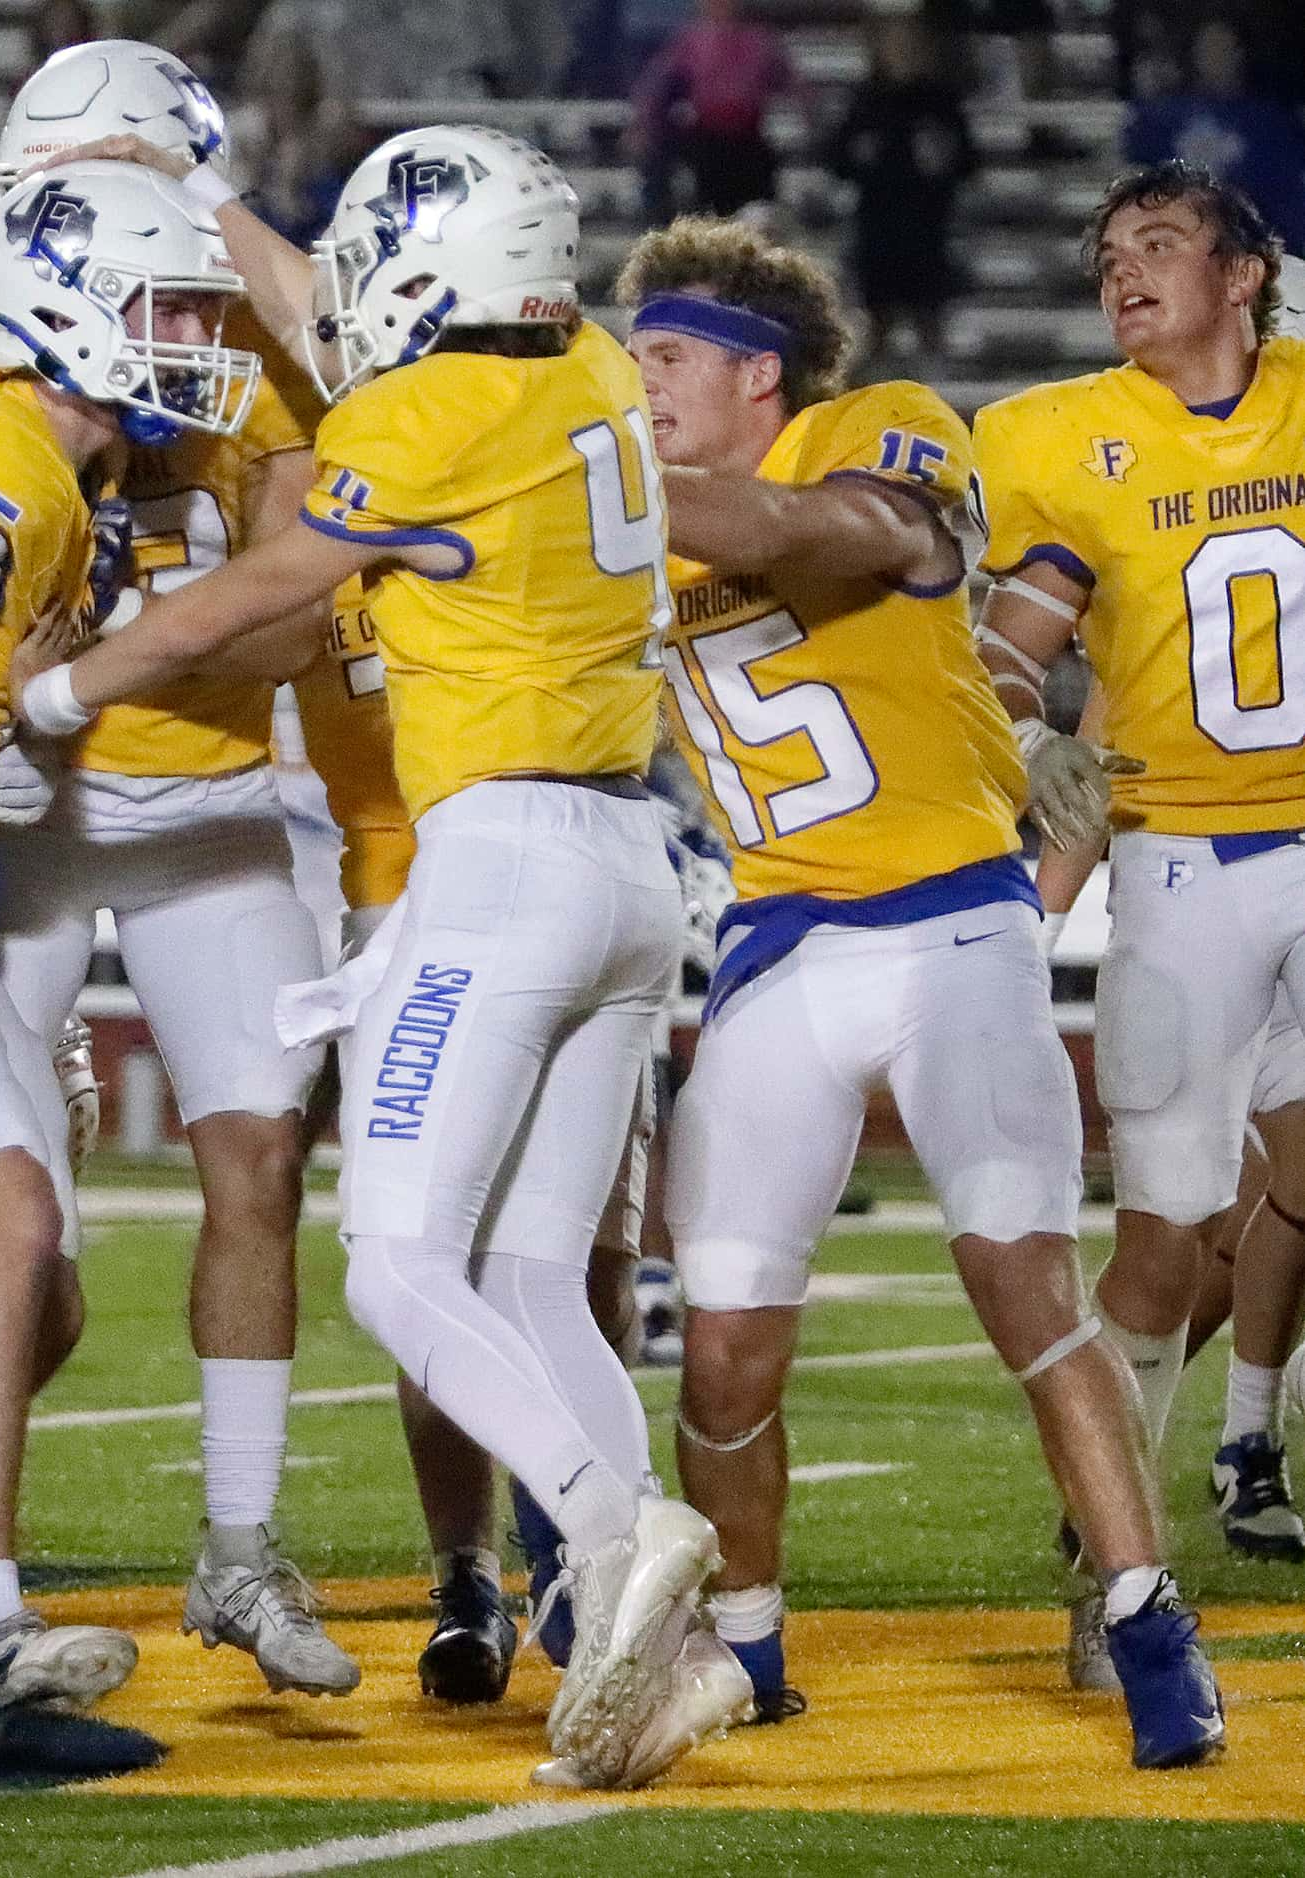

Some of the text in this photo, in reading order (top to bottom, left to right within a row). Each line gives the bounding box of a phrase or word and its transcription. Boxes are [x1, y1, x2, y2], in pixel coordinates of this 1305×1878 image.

[16, 190, 91, 262] F
[398, 154, 451, 231] F
[881, 428, 949, 484] 15
[1101, 440, 1125, 478] F
[1148, 490, 1195, 530] THE
[1182, 523, 1305, 755] 0
[662, 603, 881, 850] 15
[1166, 860, 1186, 888] F
[367, 962, 473, 1140] RACCOONS
